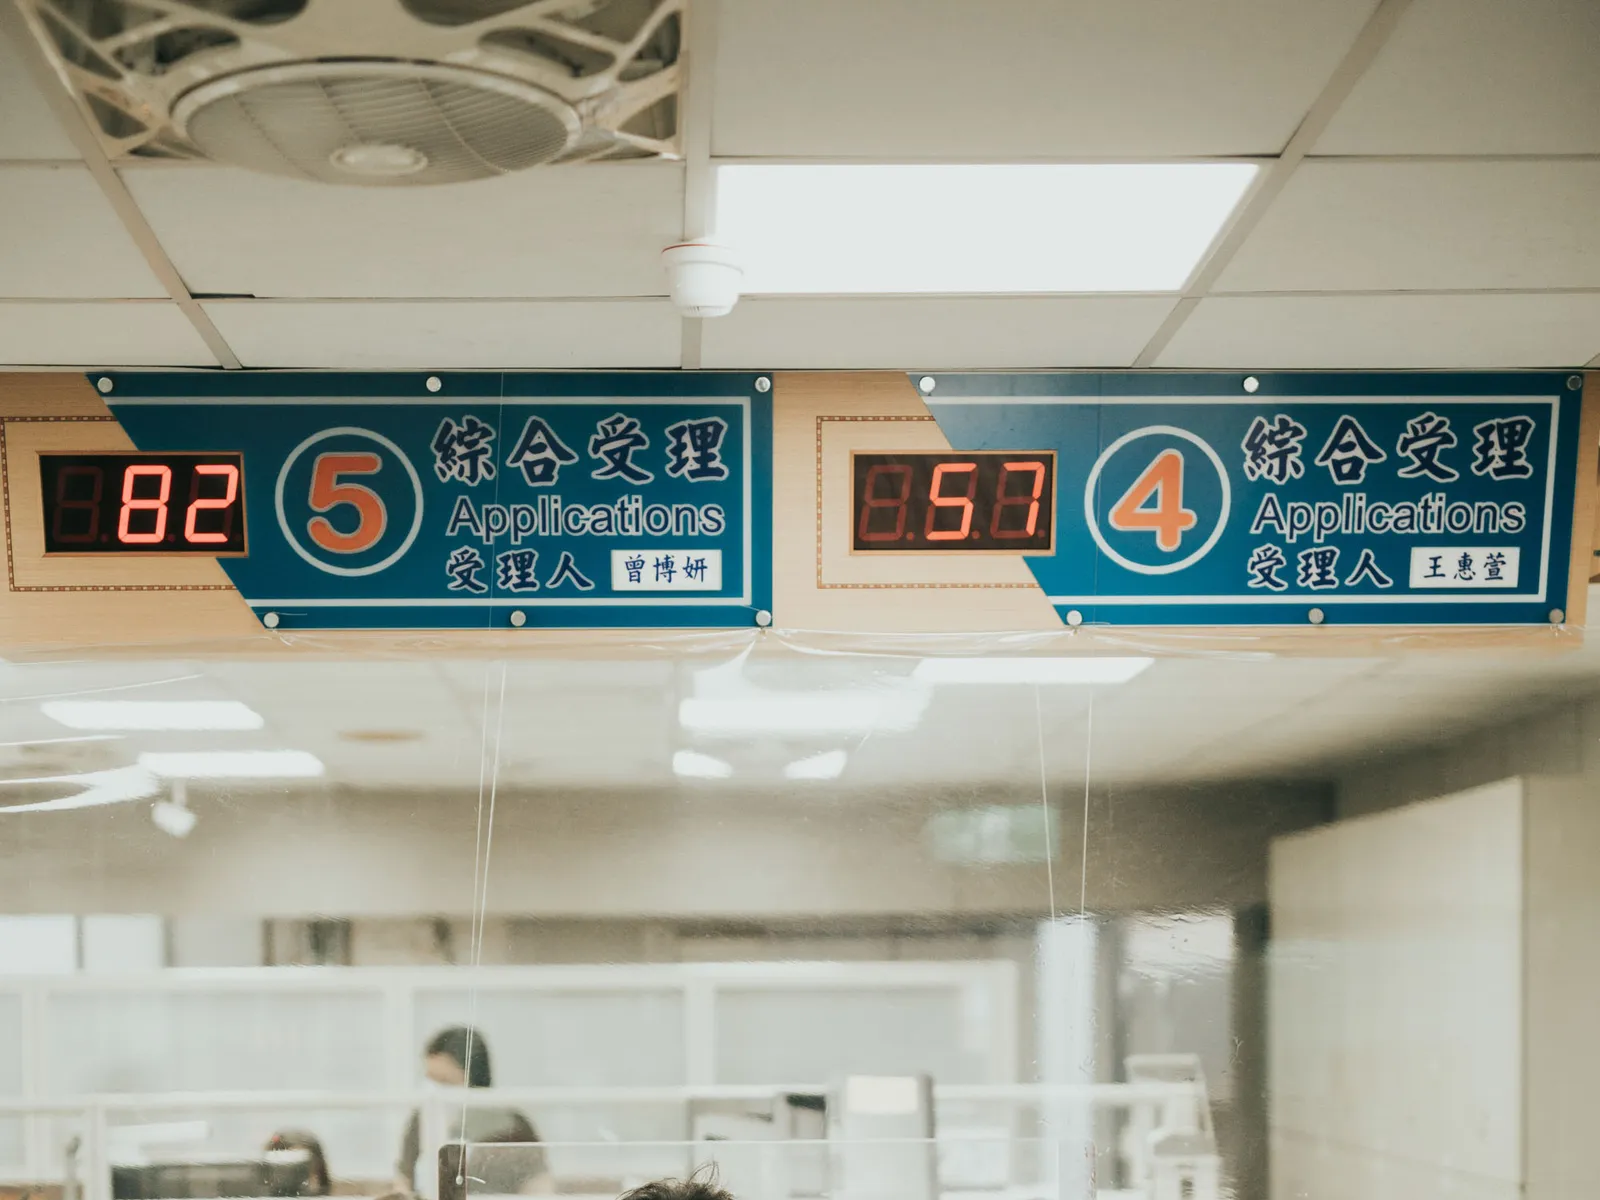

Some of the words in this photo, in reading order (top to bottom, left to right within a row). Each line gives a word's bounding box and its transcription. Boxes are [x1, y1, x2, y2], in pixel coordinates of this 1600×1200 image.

[430, 413, 730, 486] 綜合受理
[1241, 413, 1534, 484] 綜合受理
[117, 464, 238, 544] 82
[307, 452, 388, 555] 5
[446, 495, 726, 545] Applications
[927, 462, 1046, 541] 57
[1109, 448, 1198, 554] 4
[1250, 493, 1526, 543] Applications
[446, 545, 595, 593] 受理人
[1248, 543, 1393, 590] 受理人
